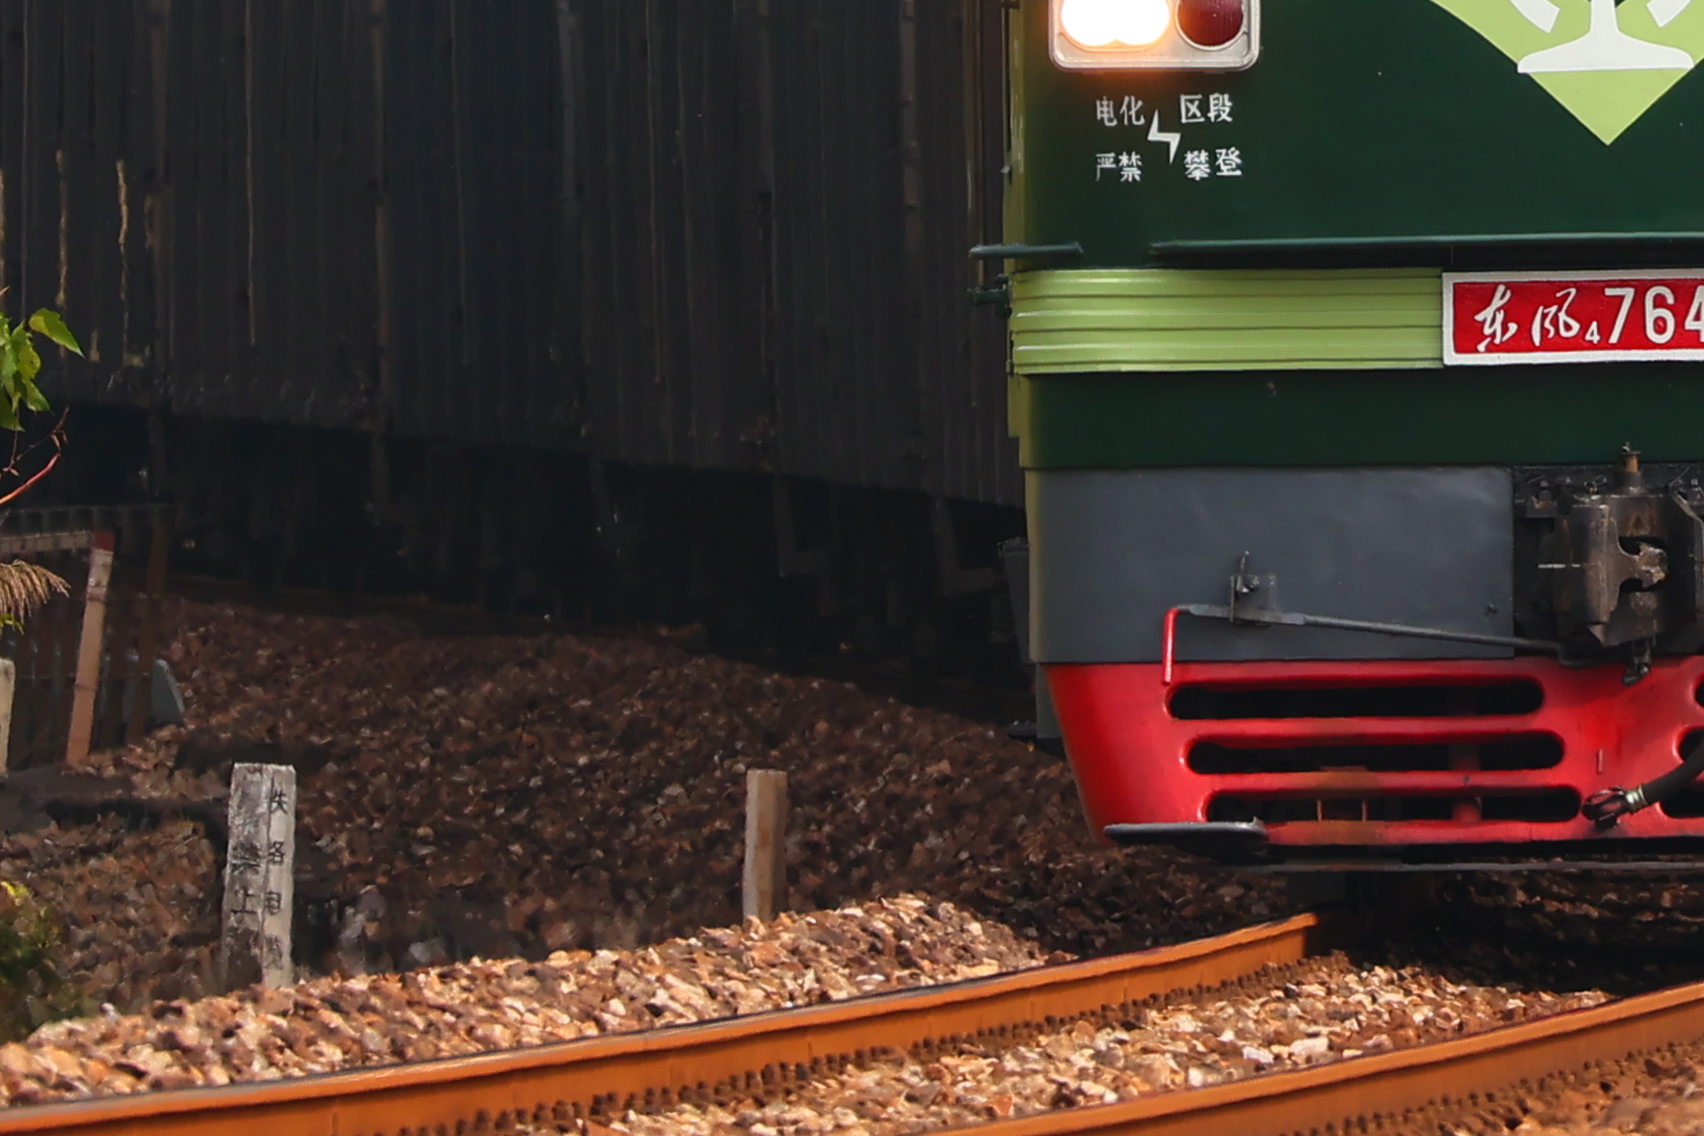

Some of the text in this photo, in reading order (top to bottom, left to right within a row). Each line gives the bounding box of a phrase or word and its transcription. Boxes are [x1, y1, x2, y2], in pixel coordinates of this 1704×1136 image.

[1095, 92, 1233, 127] 电化 区段
[1095, 147, 1243, 183] 严禁 攀登
